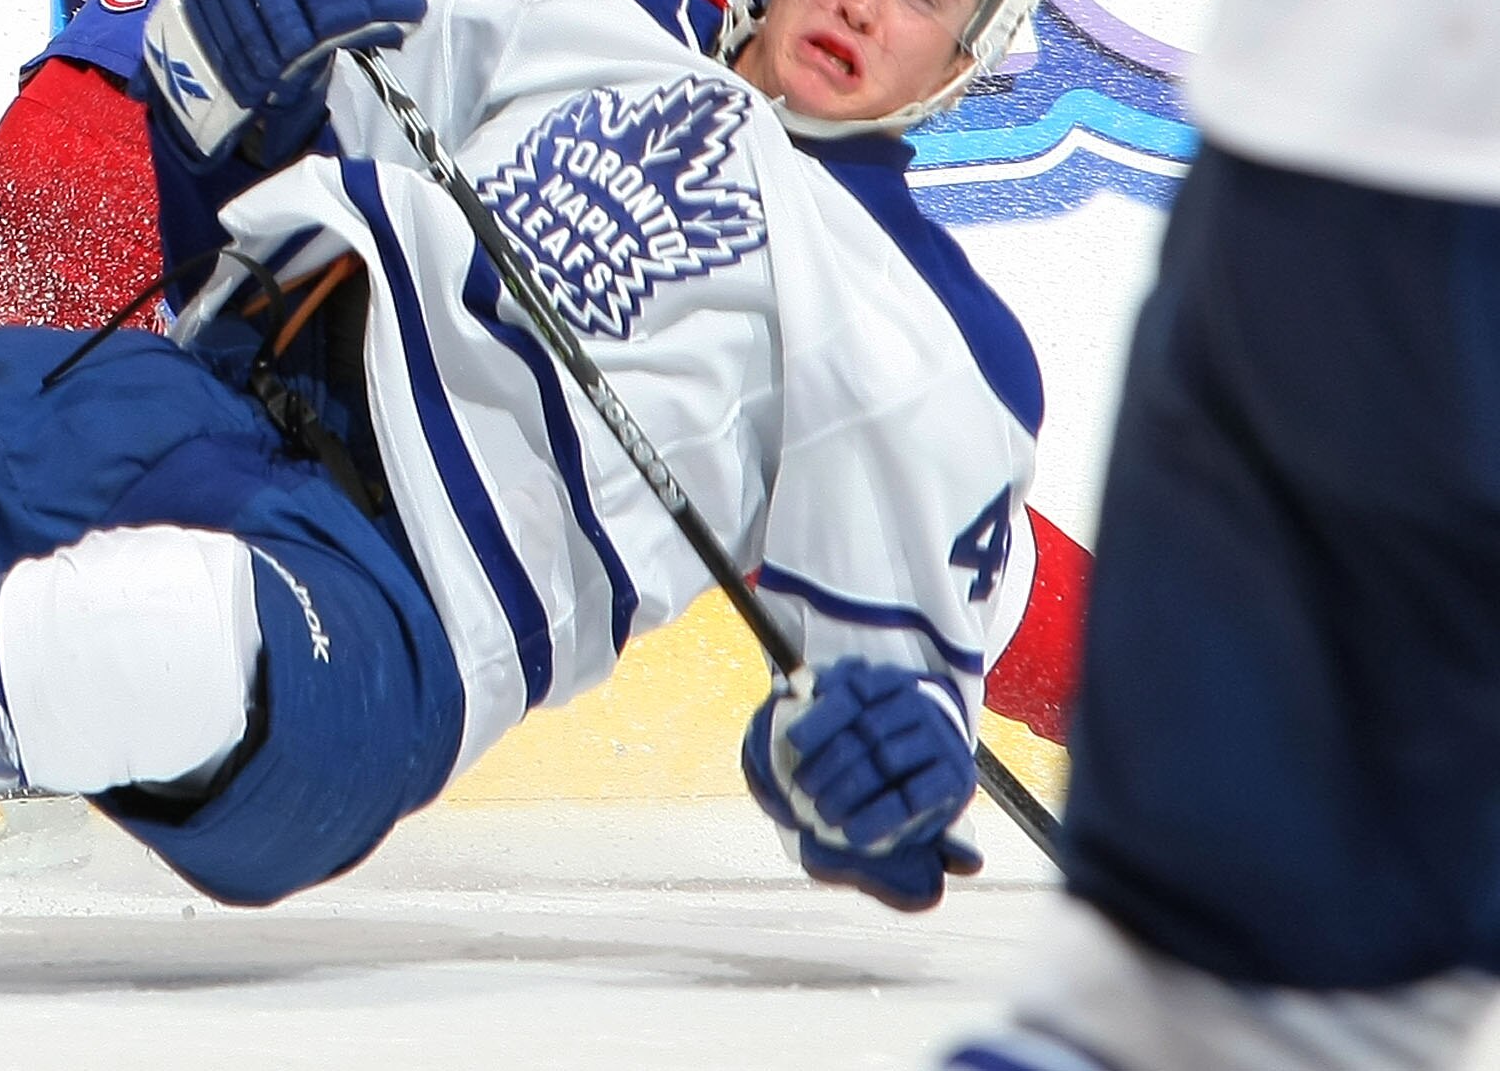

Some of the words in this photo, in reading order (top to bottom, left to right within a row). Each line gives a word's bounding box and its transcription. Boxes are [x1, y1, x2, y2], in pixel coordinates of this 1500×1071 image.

[505, 192, 613, 295] LEAFS
[537, 173, 640, 270] MAPLE
[553, 136, 689, 260] TORONTO
